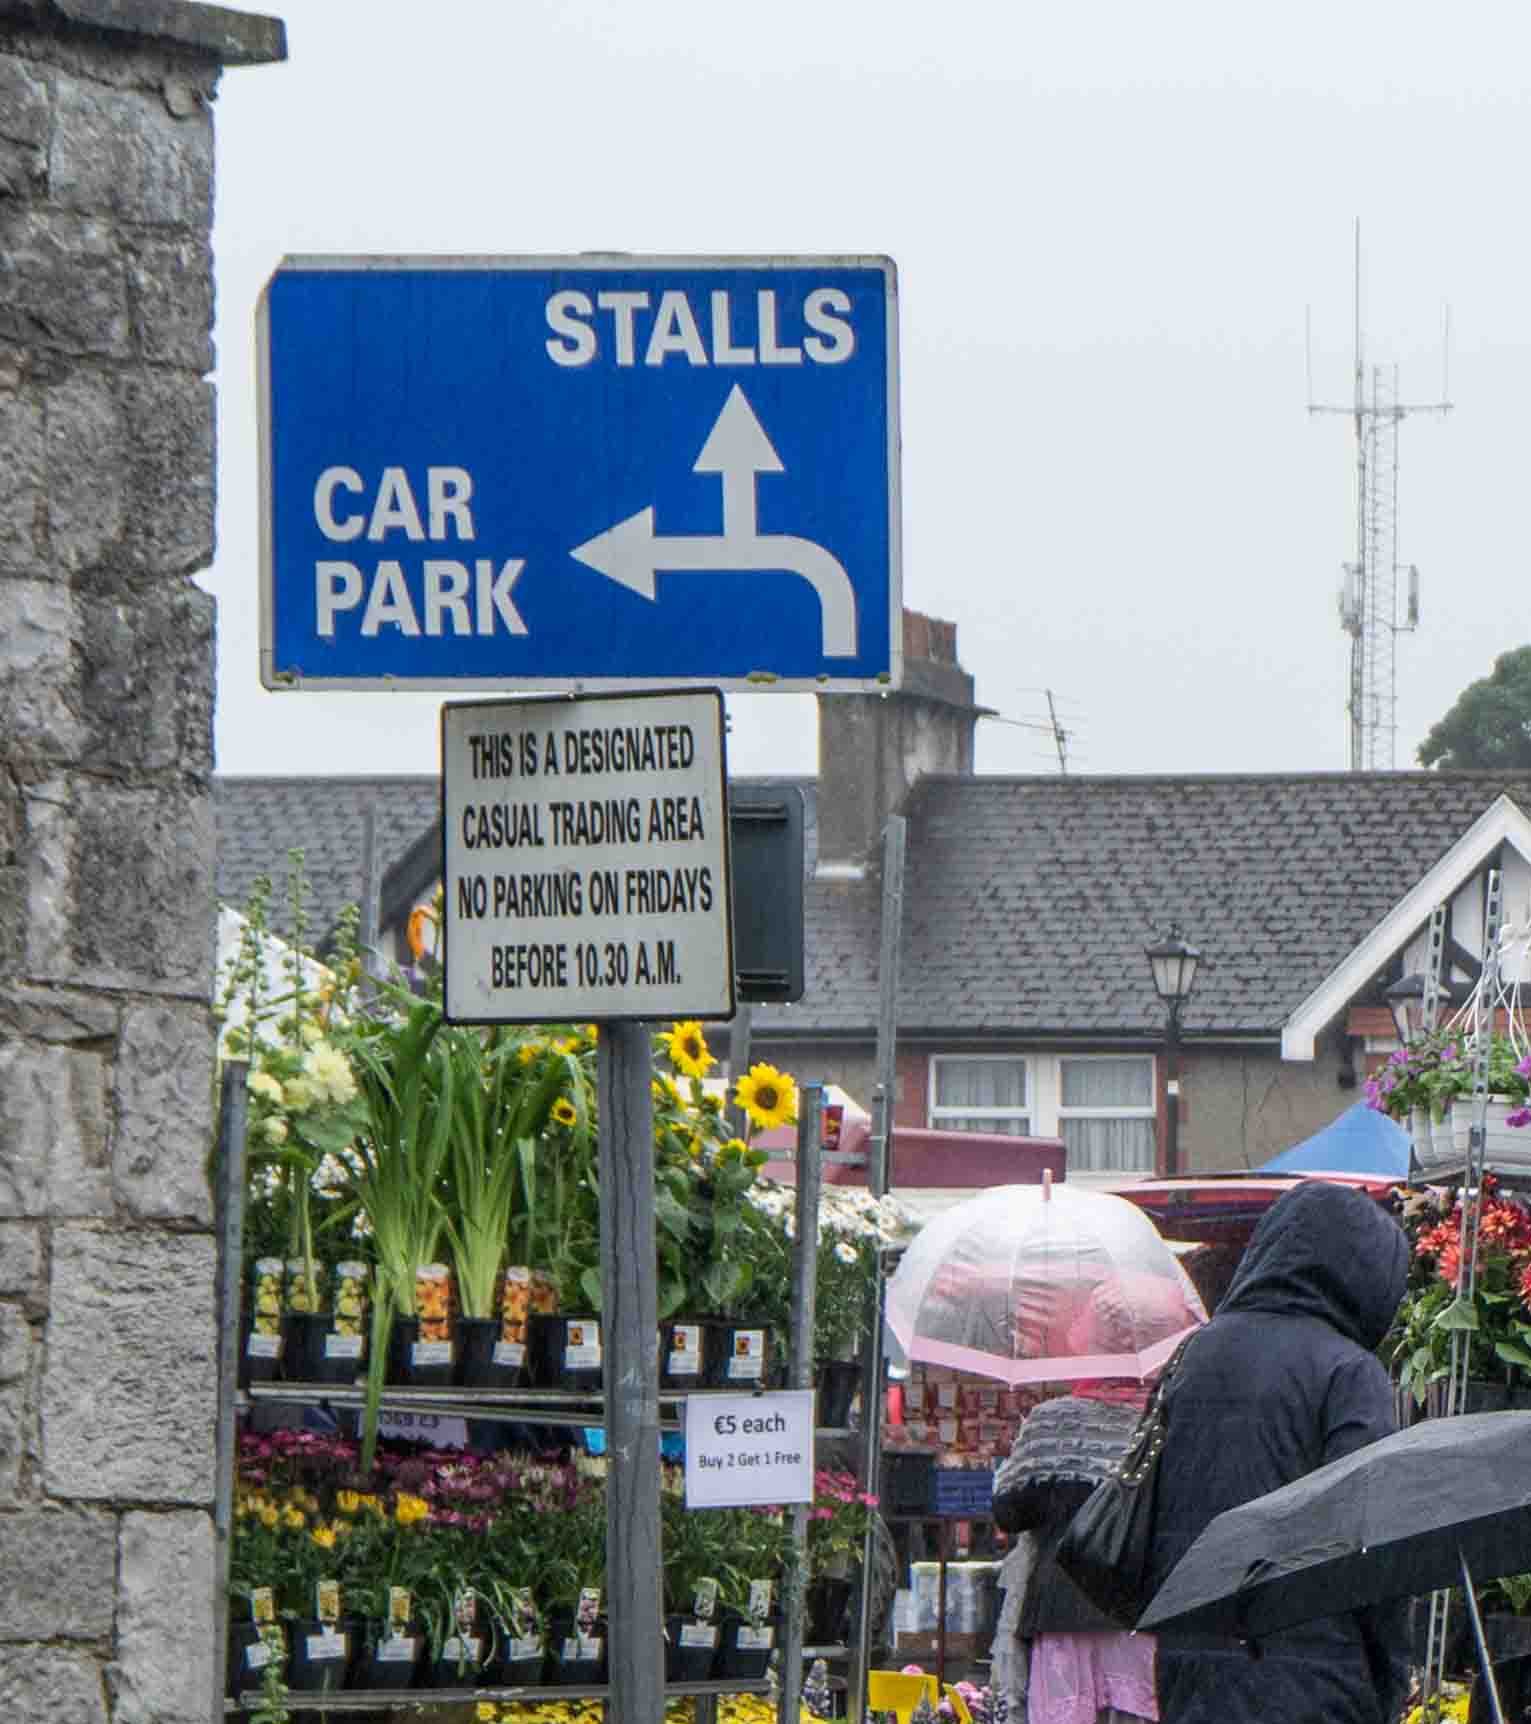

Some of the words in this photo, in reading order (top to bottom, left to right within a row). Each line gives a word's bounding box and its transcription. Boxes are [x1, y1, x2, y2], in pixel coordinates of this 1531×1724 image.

[545, 288, 857, 367] STALLS
[313, 466, 476, 543] CAR
[314, 558, 529, 638] PARK
[469, 732, 513, 779] THIS
[519, 732, 537, 778] IS
[544, 731, 560, 775] A
[564, 725, 694, 774] DESIGNATED
[462, 803, 544, 849] CASUAL
[549, 798, 640, 846] TRADING
[648, 797, 704, 843] AREA
[458, 874, 488, 919] NO
[493, 871, 583, 918] PARKING
[588, 870, 619, 916] ON
[625, 867, 713, 914] FRIDAYS
[491, 944, 568, 988] BEFORE
[574, 943, 629, 987] 10.30
[635, 940, 683, 985] A.M.
[714, 1415, 737, 1435] €5
[742, 1411, 786, 1434] each
[698, 1453, 723, 1470] Buy
[727, 1452, 735, 1467] 2
[738, 1452, 760, 1467] Get
[764, 1451, 771, 1465] 1
[775, 1450, 801, 1465] Free
